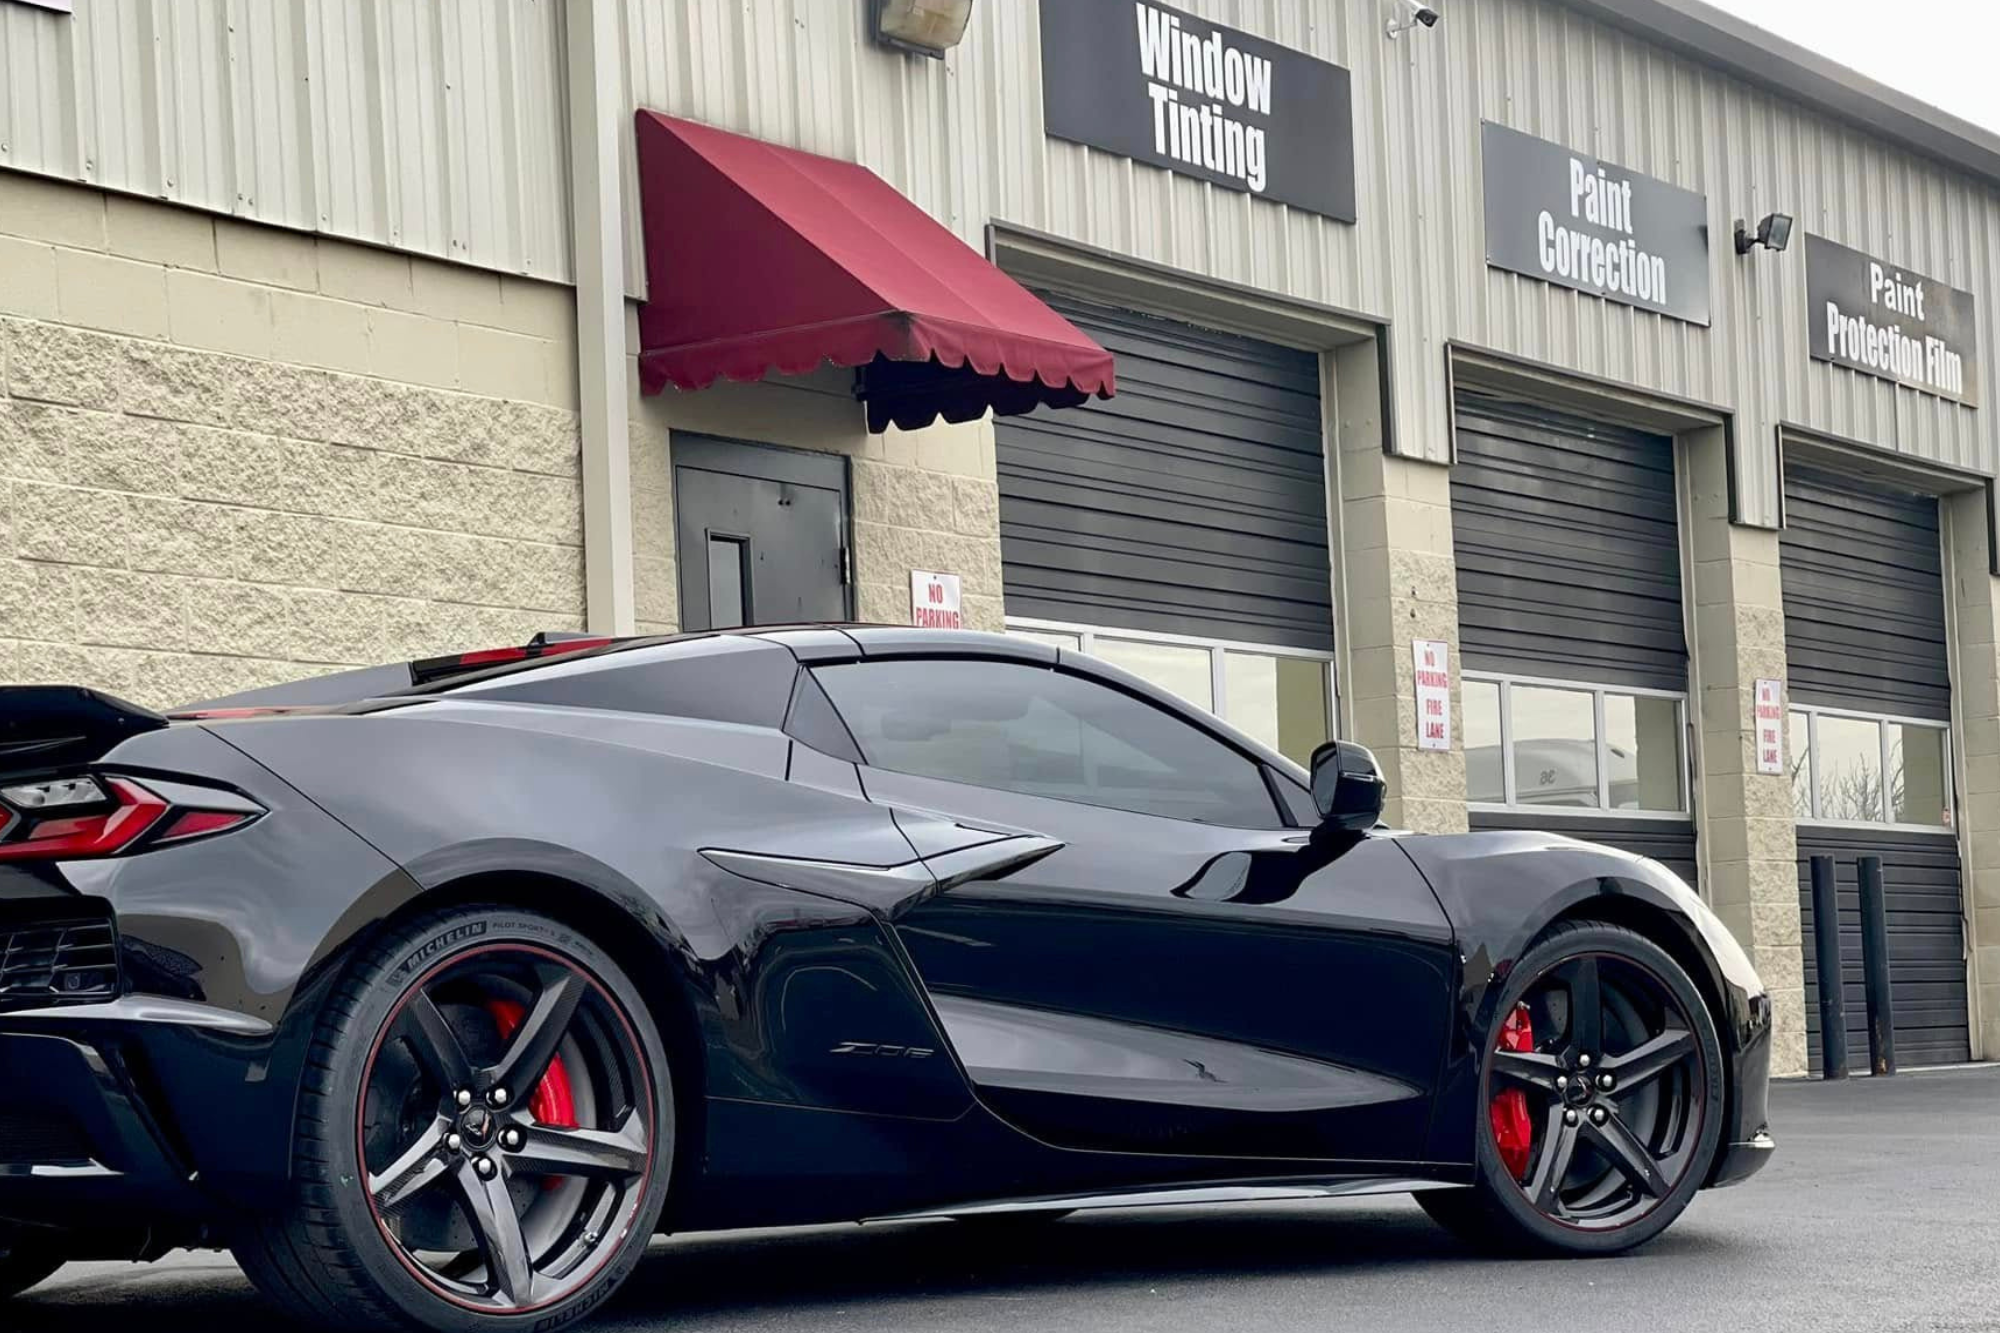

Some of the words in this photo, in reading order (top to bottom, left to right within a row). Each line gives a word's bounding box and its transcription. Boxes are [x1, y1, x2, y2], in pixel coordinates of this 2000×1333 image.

[1136, 2, 1271, 115] Window
[1148, 82, 1266, 192] Tinting
[1570, 157, 1633, 234] Paint
[1538, 210, 1666, 305] Correction
[1870, 262, 1925, 321] Paint
[1826, 301, 1924, 382] Protection
[1925, 335, 1962, 394] Film
[916, 606, 959, 629] PARKING
[928, 583, 943, 604] NO
[1417, 670, 1447, 688] PARKING
[1426, 699, 1443, 716] FIRE
[1426, 722, 1444, 739] LANE
[406, 921, 483, 970] MICHELIN
